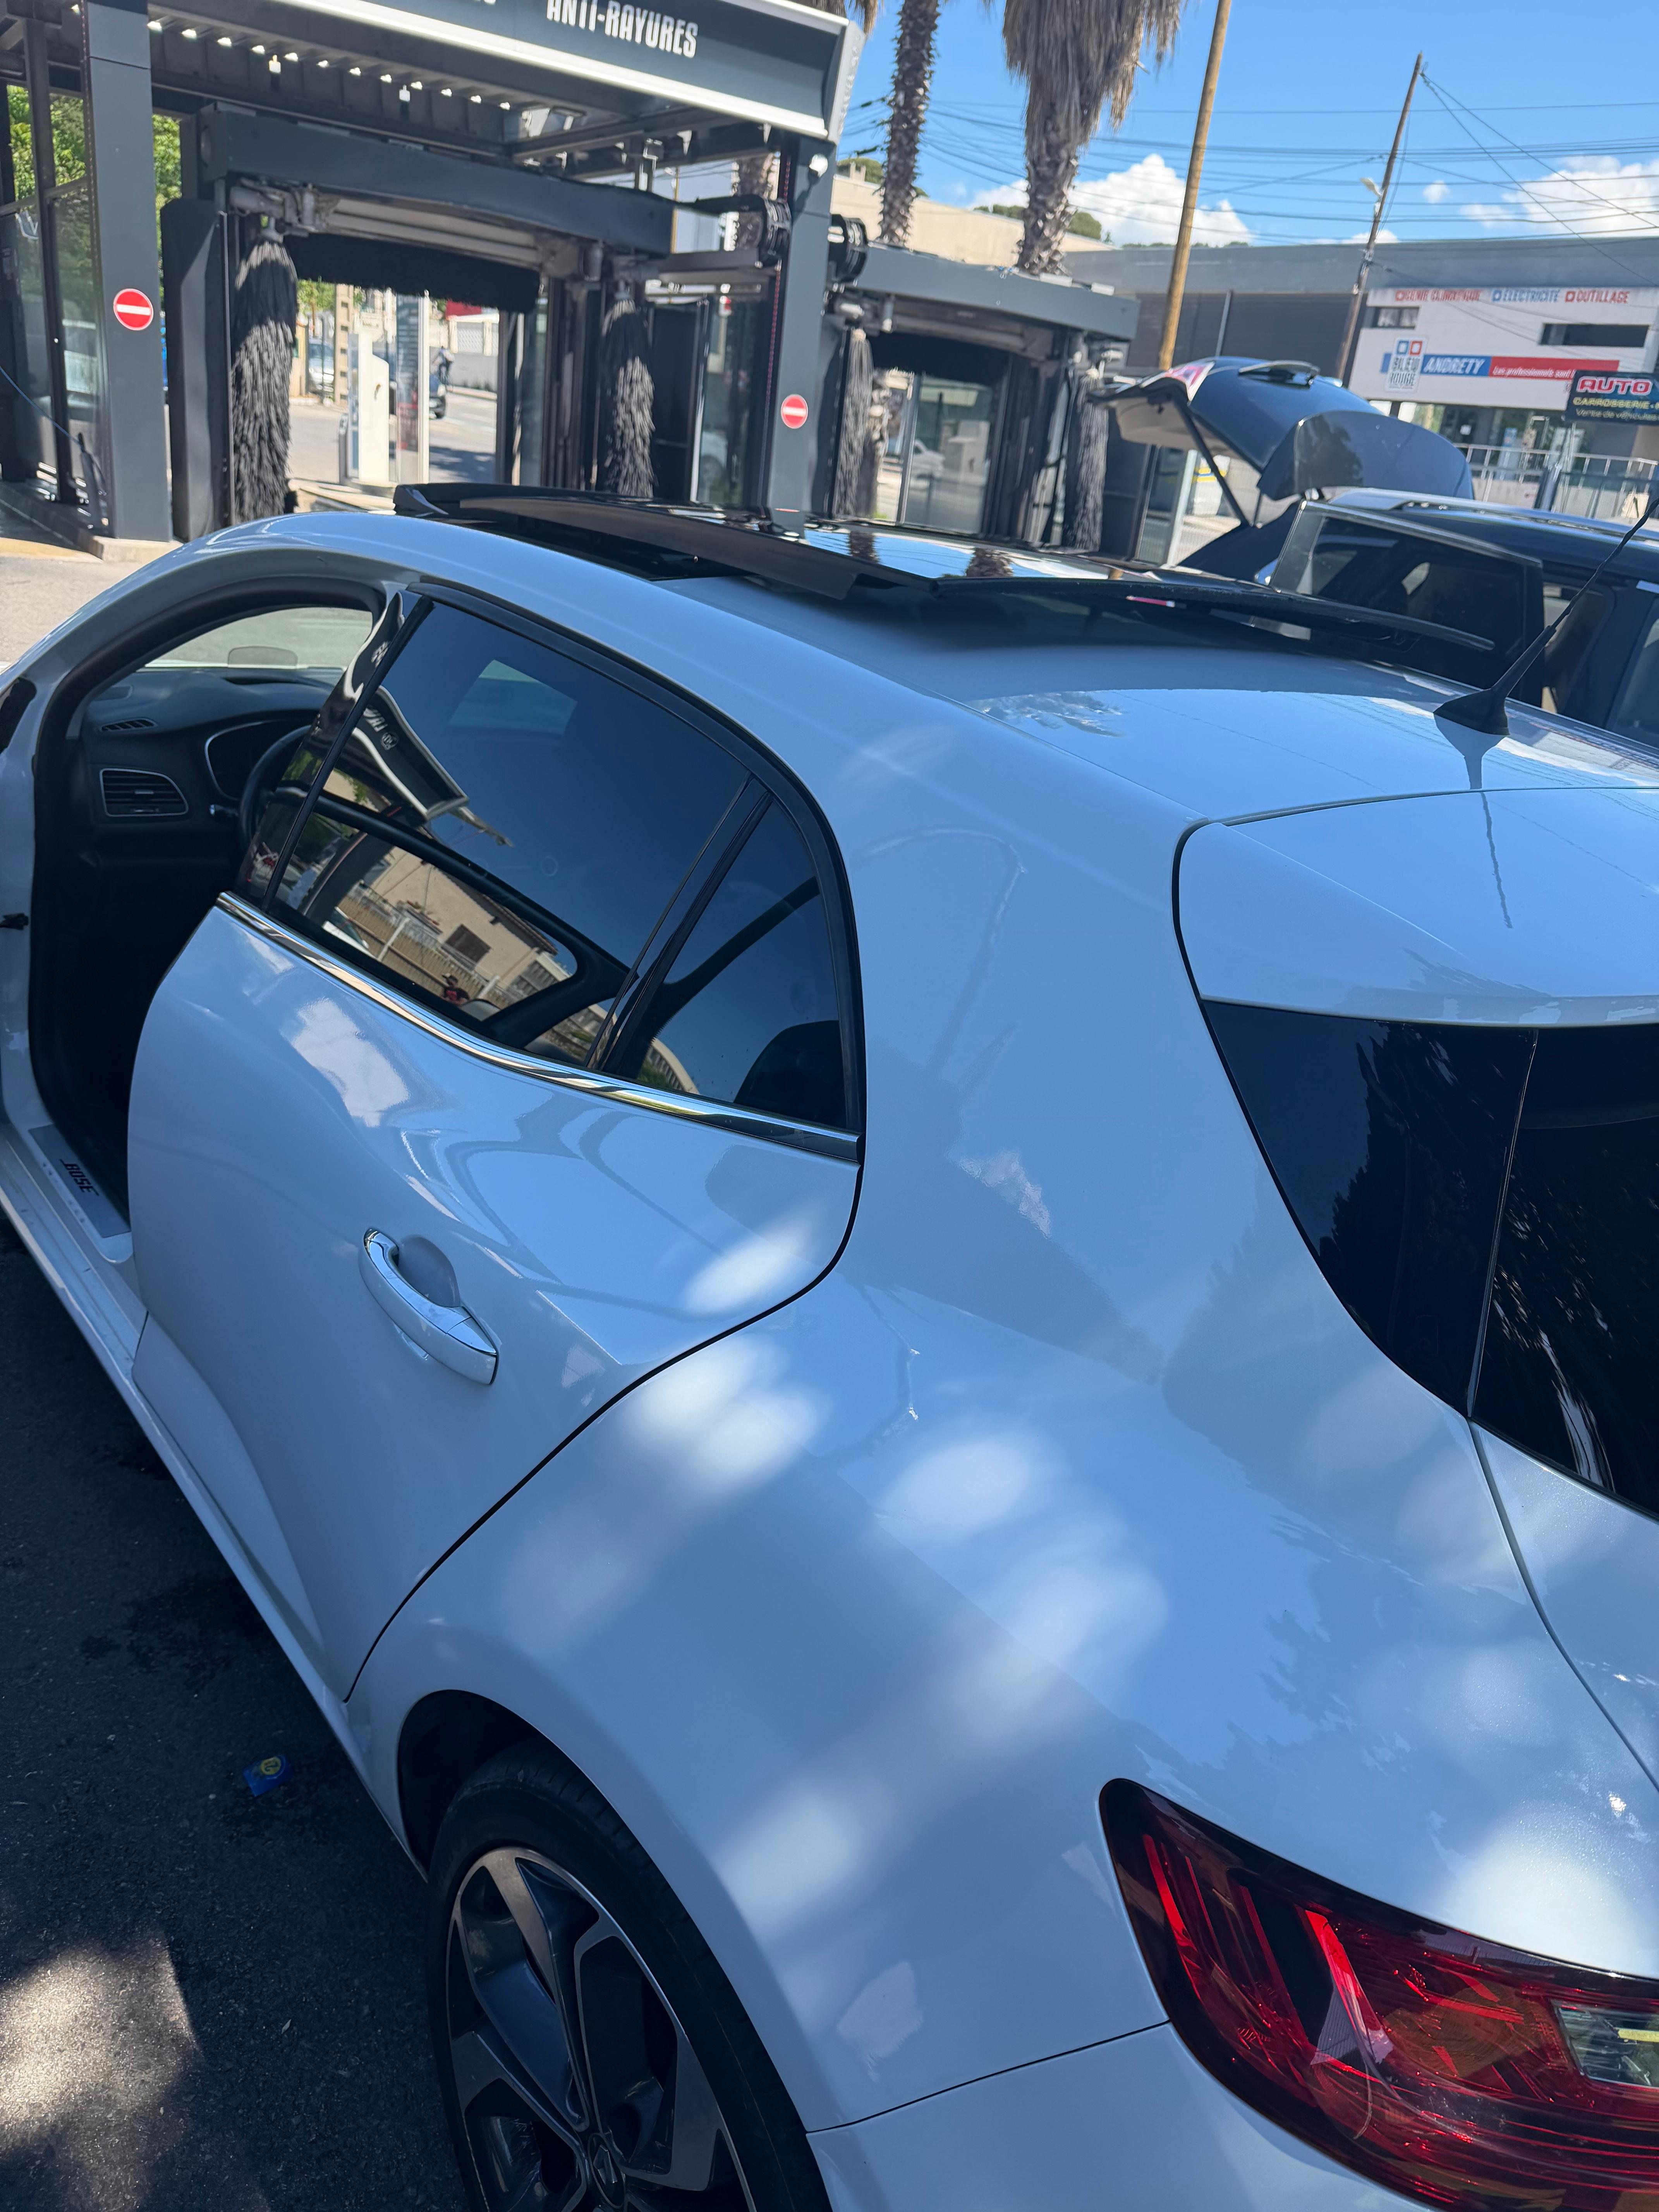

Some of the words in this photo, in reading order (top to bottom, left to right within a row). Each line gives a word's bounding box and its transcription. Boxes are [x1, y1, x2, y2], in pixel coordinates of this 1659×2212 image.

[546, 0, 698, 59] ANTI-RAYURES
[1576, 290, 1630, 304] OUTILLAGE
[1423, 357, 1485, 374] ANDRETY
[1576, 376, 1653, 396] AUTO
[60, 1159, 99, 1196] BOSE
